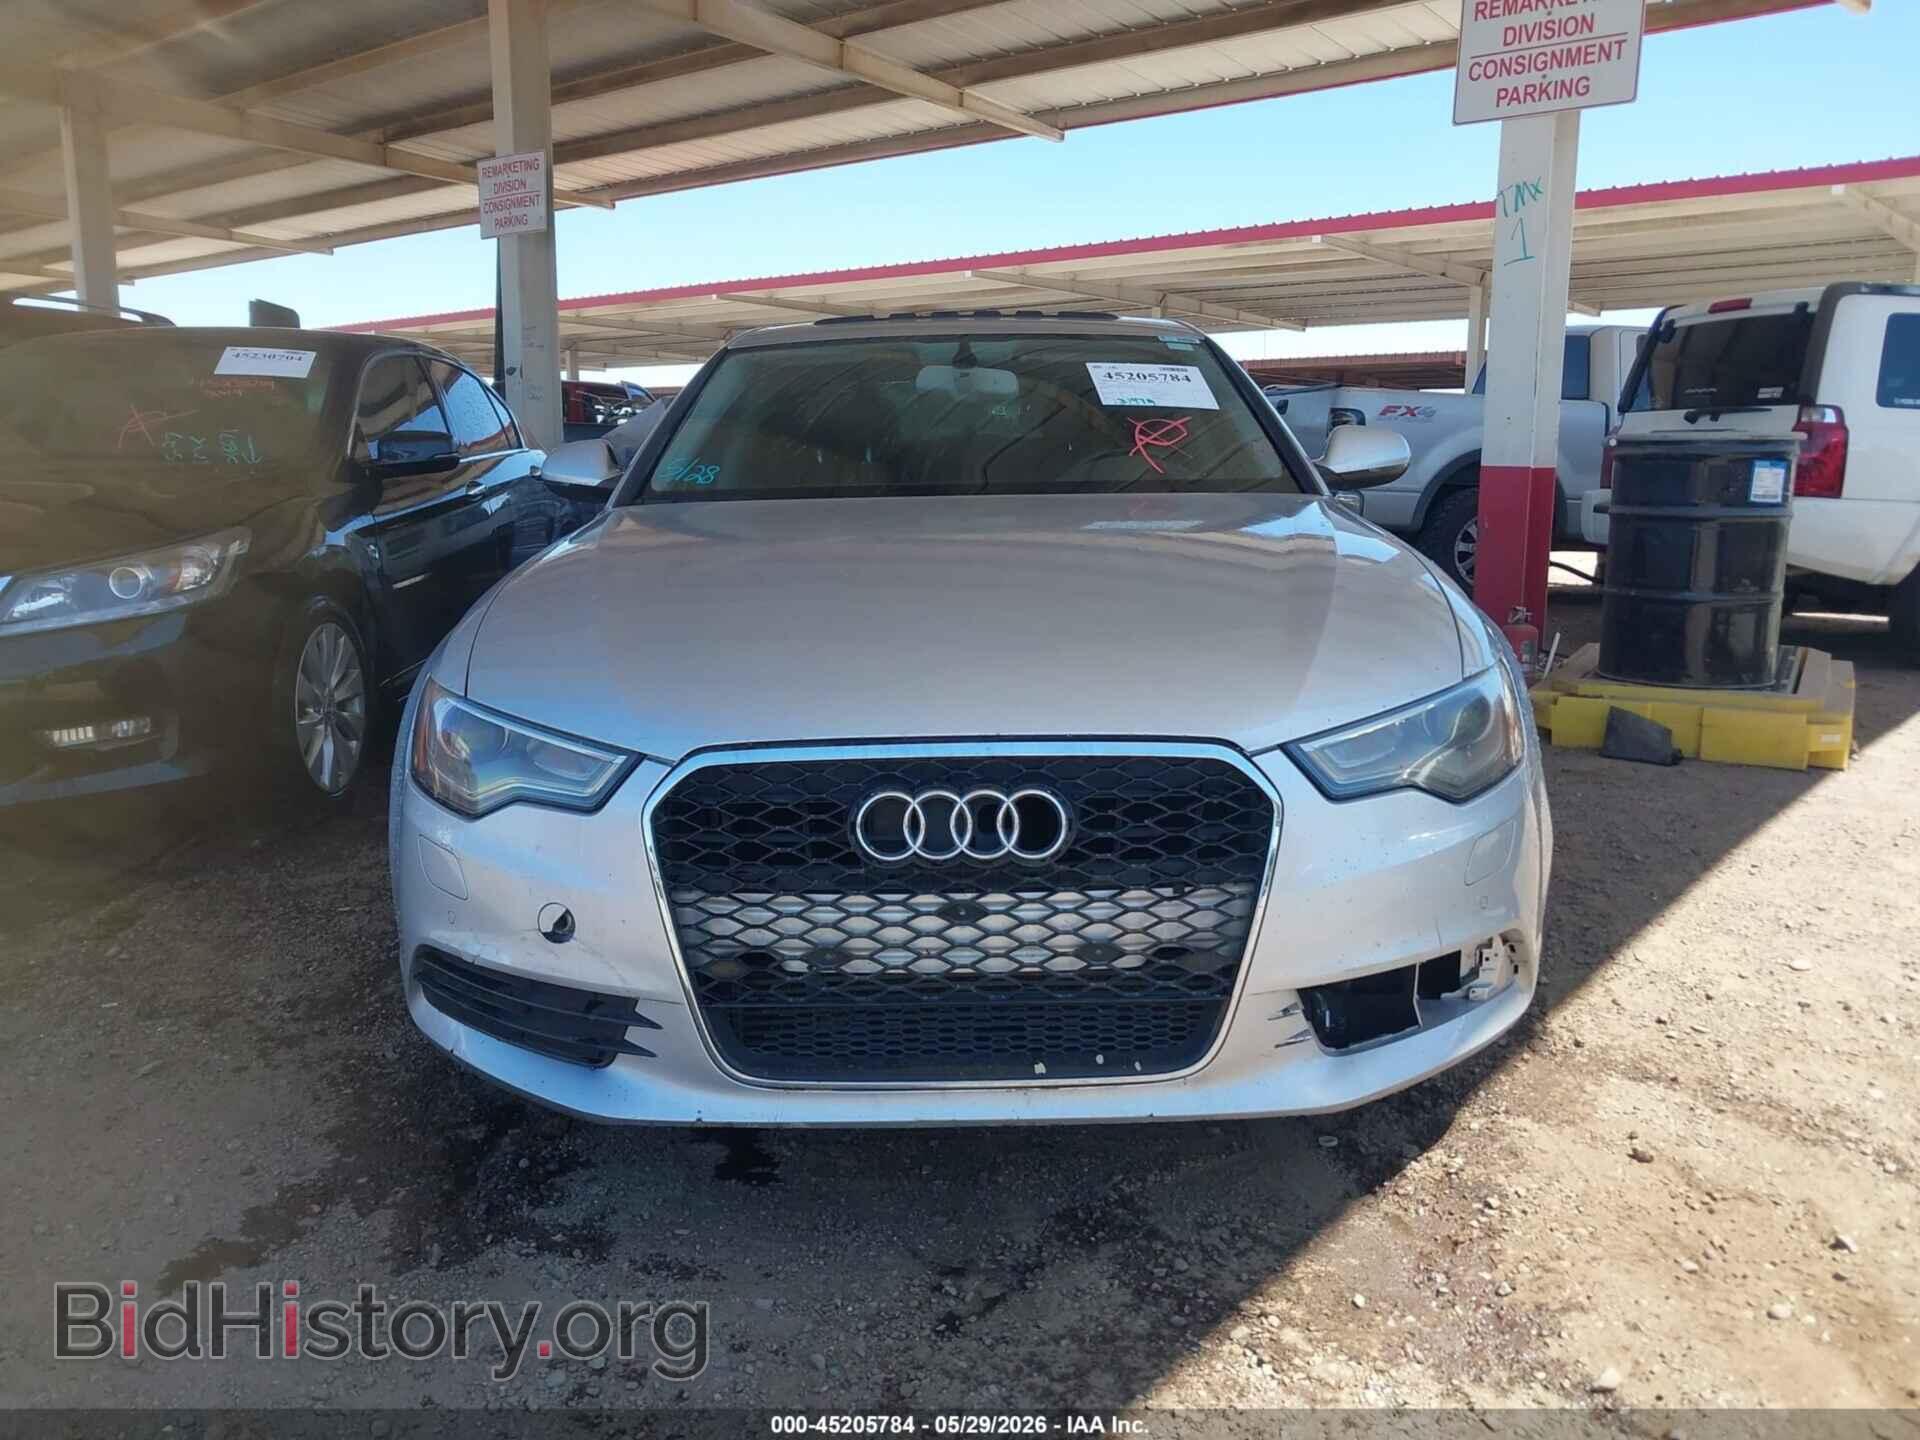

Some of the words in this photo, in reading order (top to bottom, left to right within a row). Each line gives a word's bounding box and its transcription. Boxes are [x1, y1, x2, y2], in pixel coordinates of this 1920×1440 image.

[1503, 13, 1595, 47] DIVISION
[1468, 39, 1627, 81] CONSIGNMENT
[1496, 76, 1591, 107] PARKING
[481, 158, 540, 178] REMARKETING
[493, 179, 527, 194] DIVISION
[483, 194, 540, 214] CONSIGNMENT
[495, 214, 528, 229] PARKING
[1503, 217, 1536, 267] 1
[1103, 372, 1192, 383] 45205784
